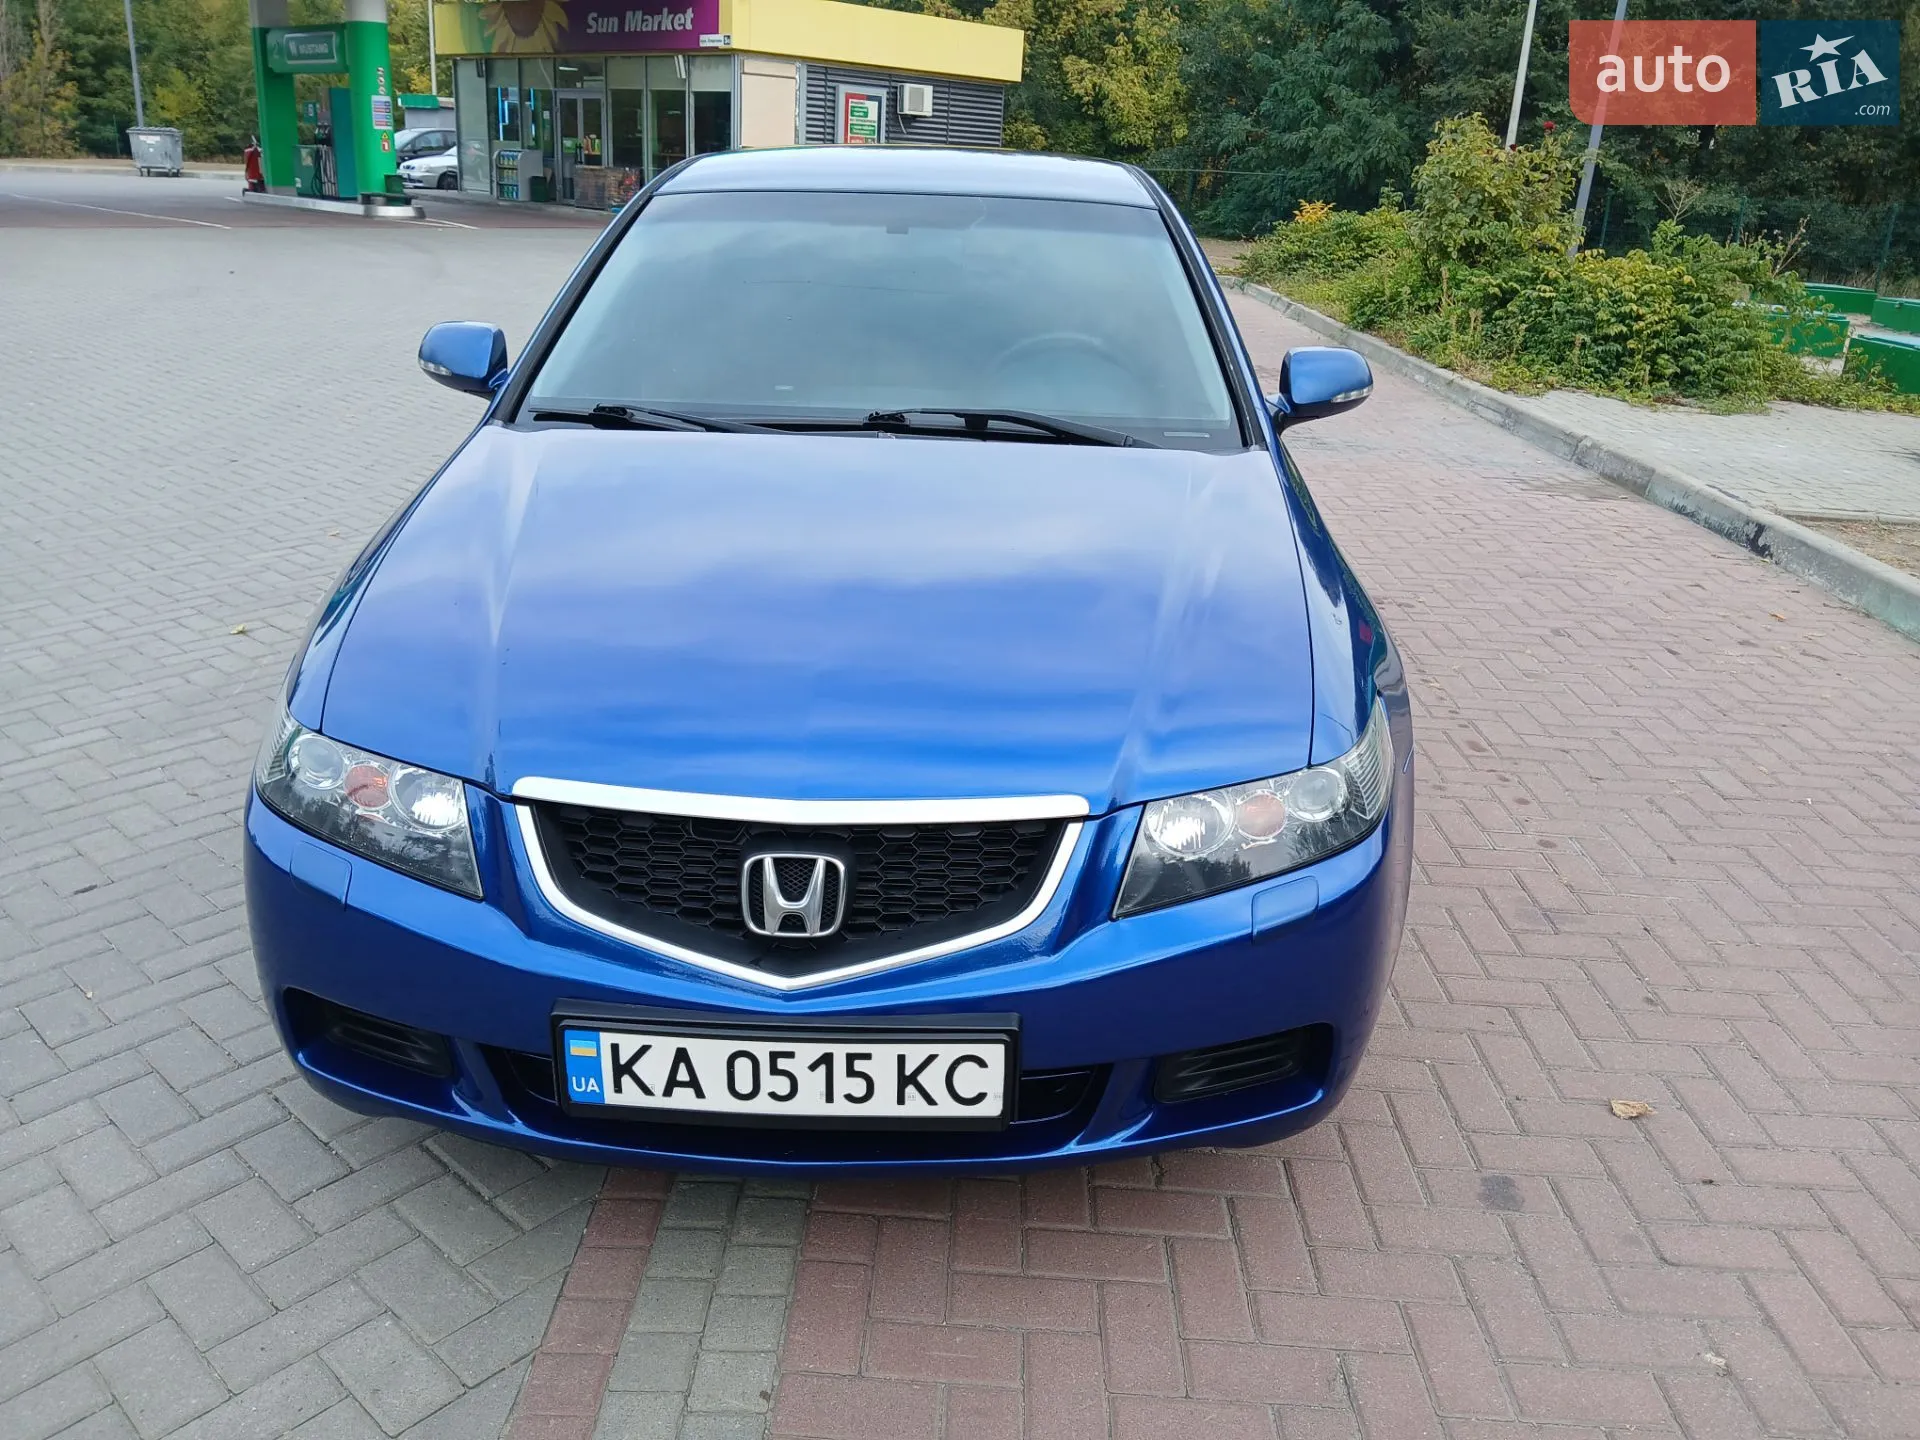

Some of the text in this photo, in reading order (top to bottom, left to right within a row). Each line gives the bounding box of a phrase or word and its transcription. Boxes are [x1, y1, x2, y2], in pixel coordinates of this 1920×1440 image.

[586, 7, 694, 33] Sun Market
[572, 1076, 600, 1093] UA
[610, 1042, 989, 1107] KA 0515 KC
